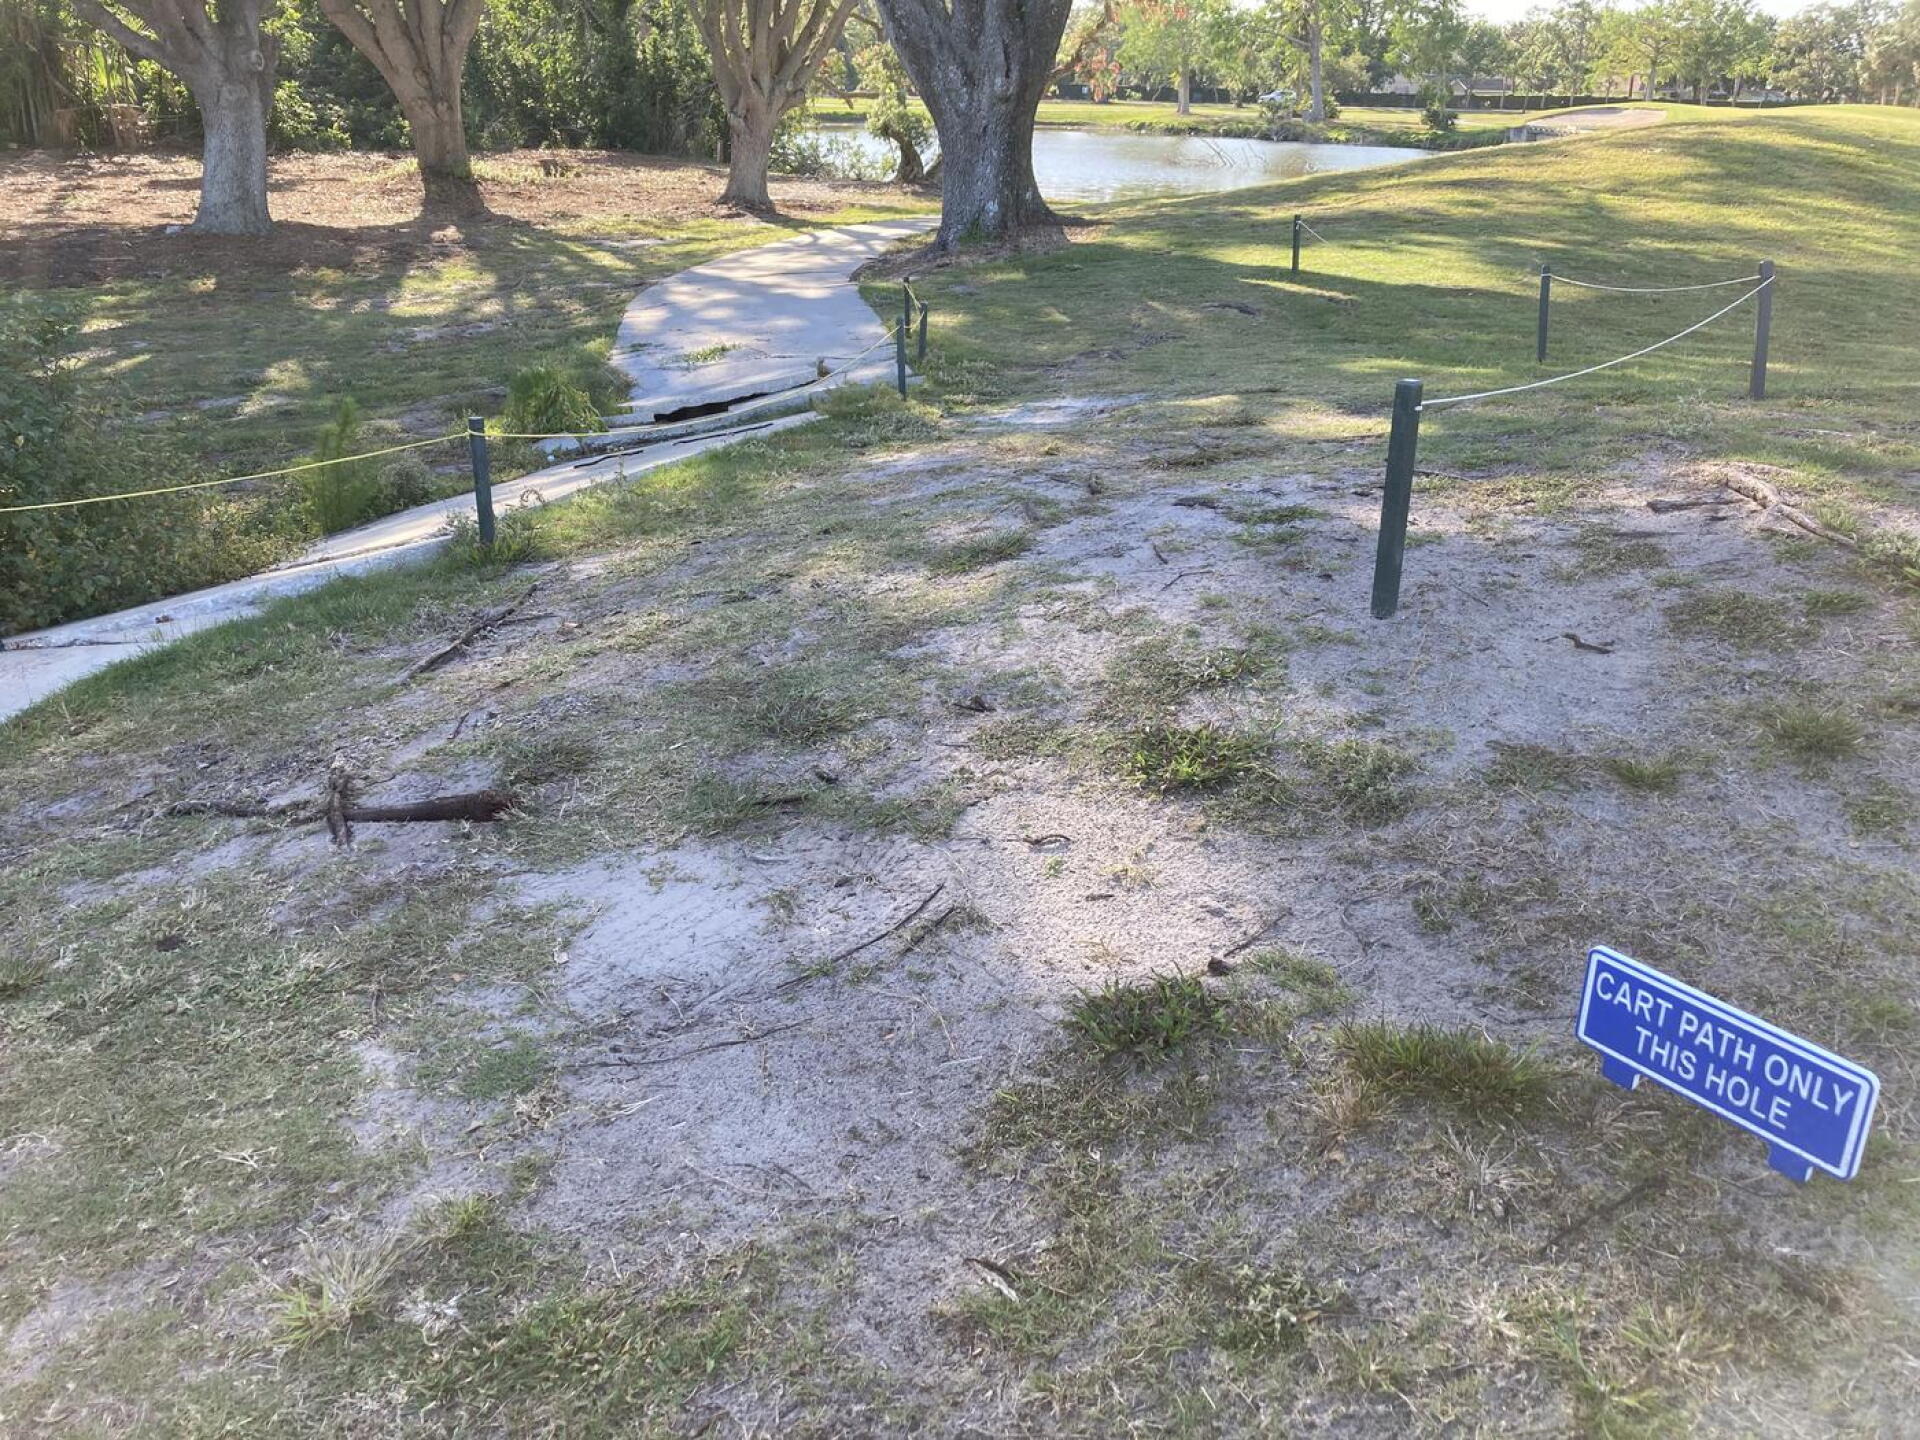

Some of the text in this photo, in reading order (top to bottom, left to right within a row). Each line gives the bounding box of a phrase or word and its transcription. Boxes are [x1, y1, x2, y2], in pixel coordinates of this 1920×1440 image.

[1595, 971, 1854, 1116] CART PATH ONLY
[1635, 1025, 1791, 1130] THIS HOLE
